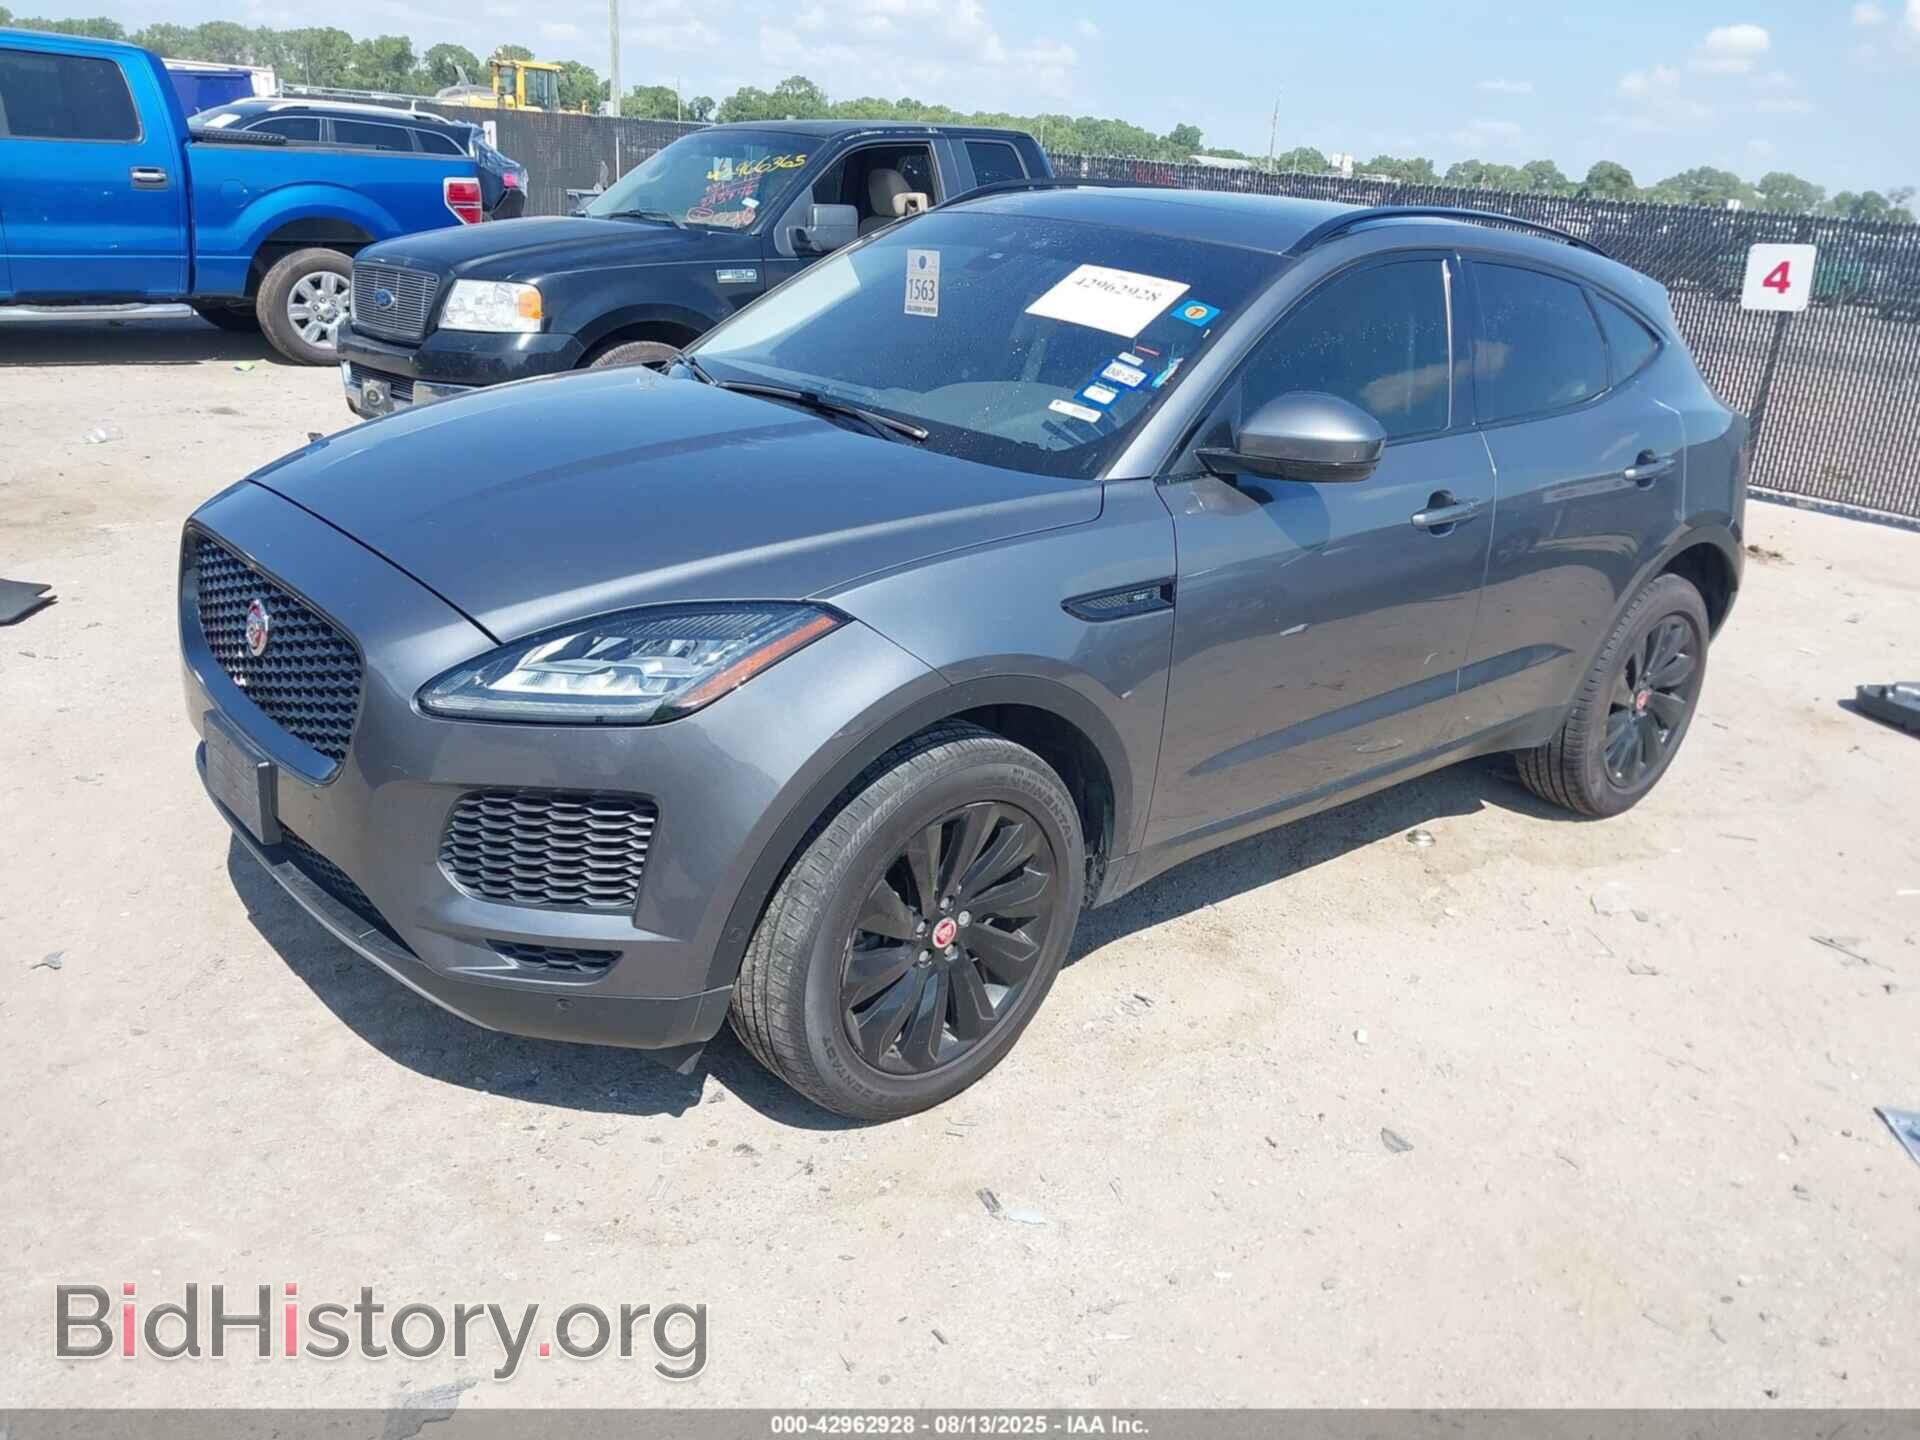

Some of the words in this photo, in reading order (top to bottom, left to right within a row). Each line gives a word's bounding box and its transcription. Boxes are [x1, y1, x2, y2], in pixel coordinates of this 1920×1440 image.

[908, 279, 936, 301] 1563
[1073, 276, 1163, 302] 42962928
[1762, 260, 1791, 294] 4
